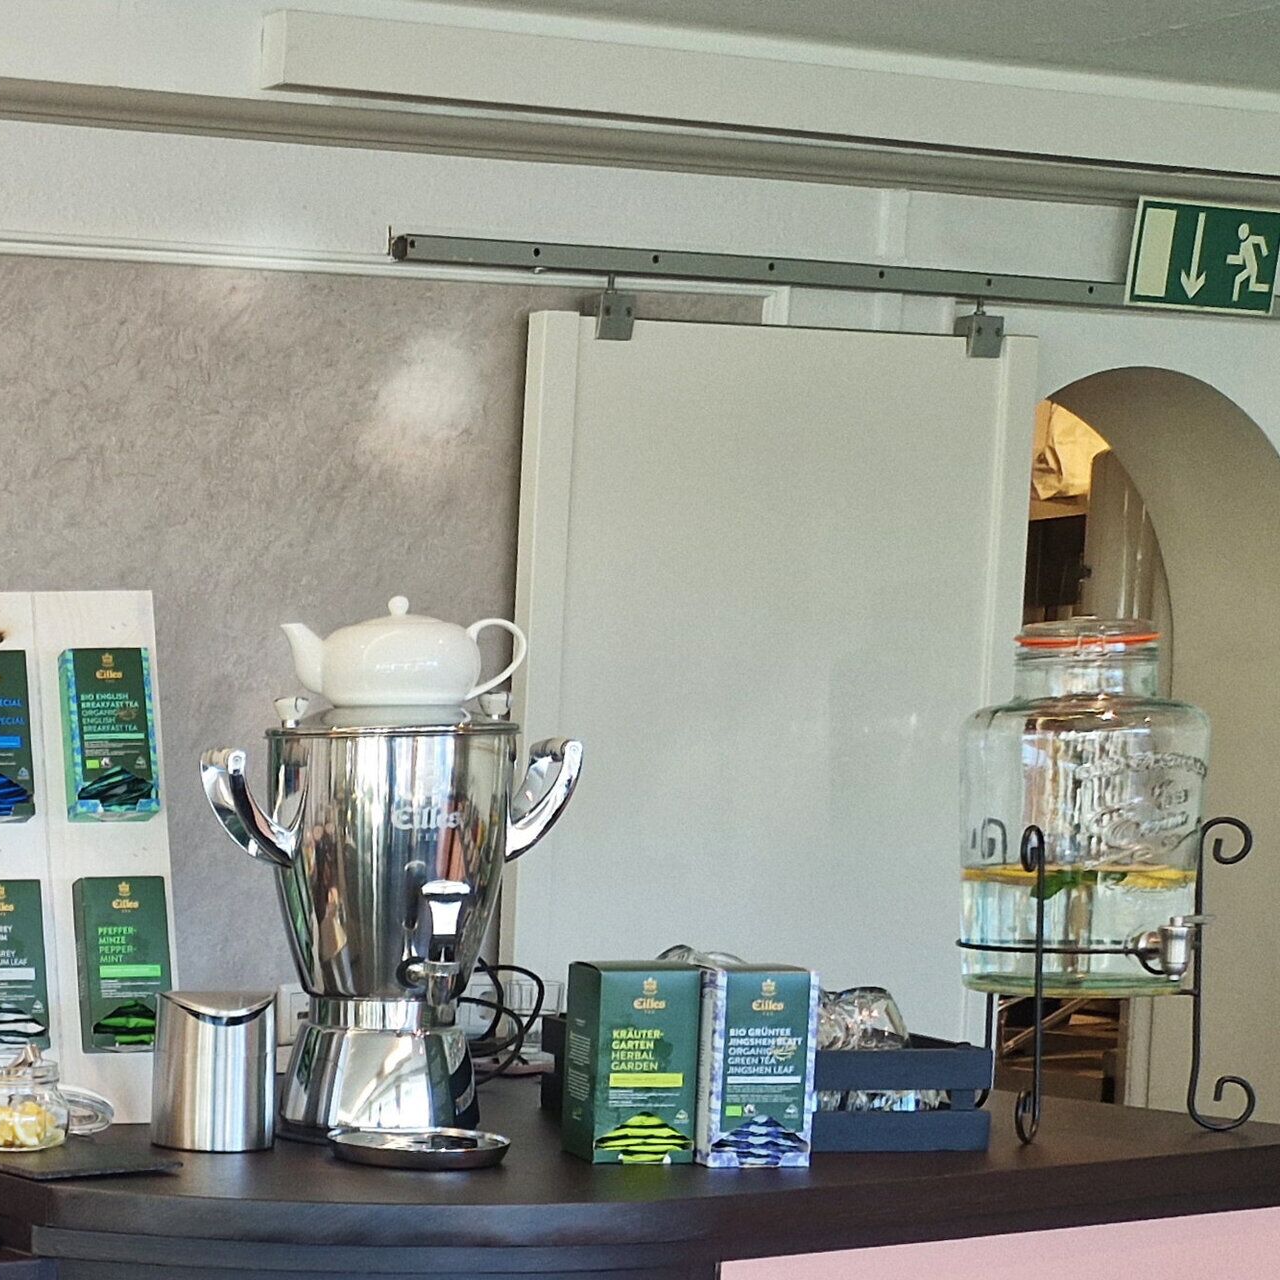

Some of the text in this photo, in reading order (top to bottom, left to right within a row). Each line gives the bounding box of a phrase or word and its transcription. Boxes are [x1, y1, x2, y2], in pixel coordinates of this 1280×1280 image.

[612, 1027, 664, 1039] KRÄUTER-
[729, 1026, 791, 1036] BIO GRÜNTEE
[611, 1040, 654, 1050] GARTEN
[611, 1051, 654, 1060] HERBAL
[728, 1057, 777, 1065] GREEN TEA
[611, 1062, 658, 1071] GARDEN
[774, 1066, 794, 1074] LEAF
